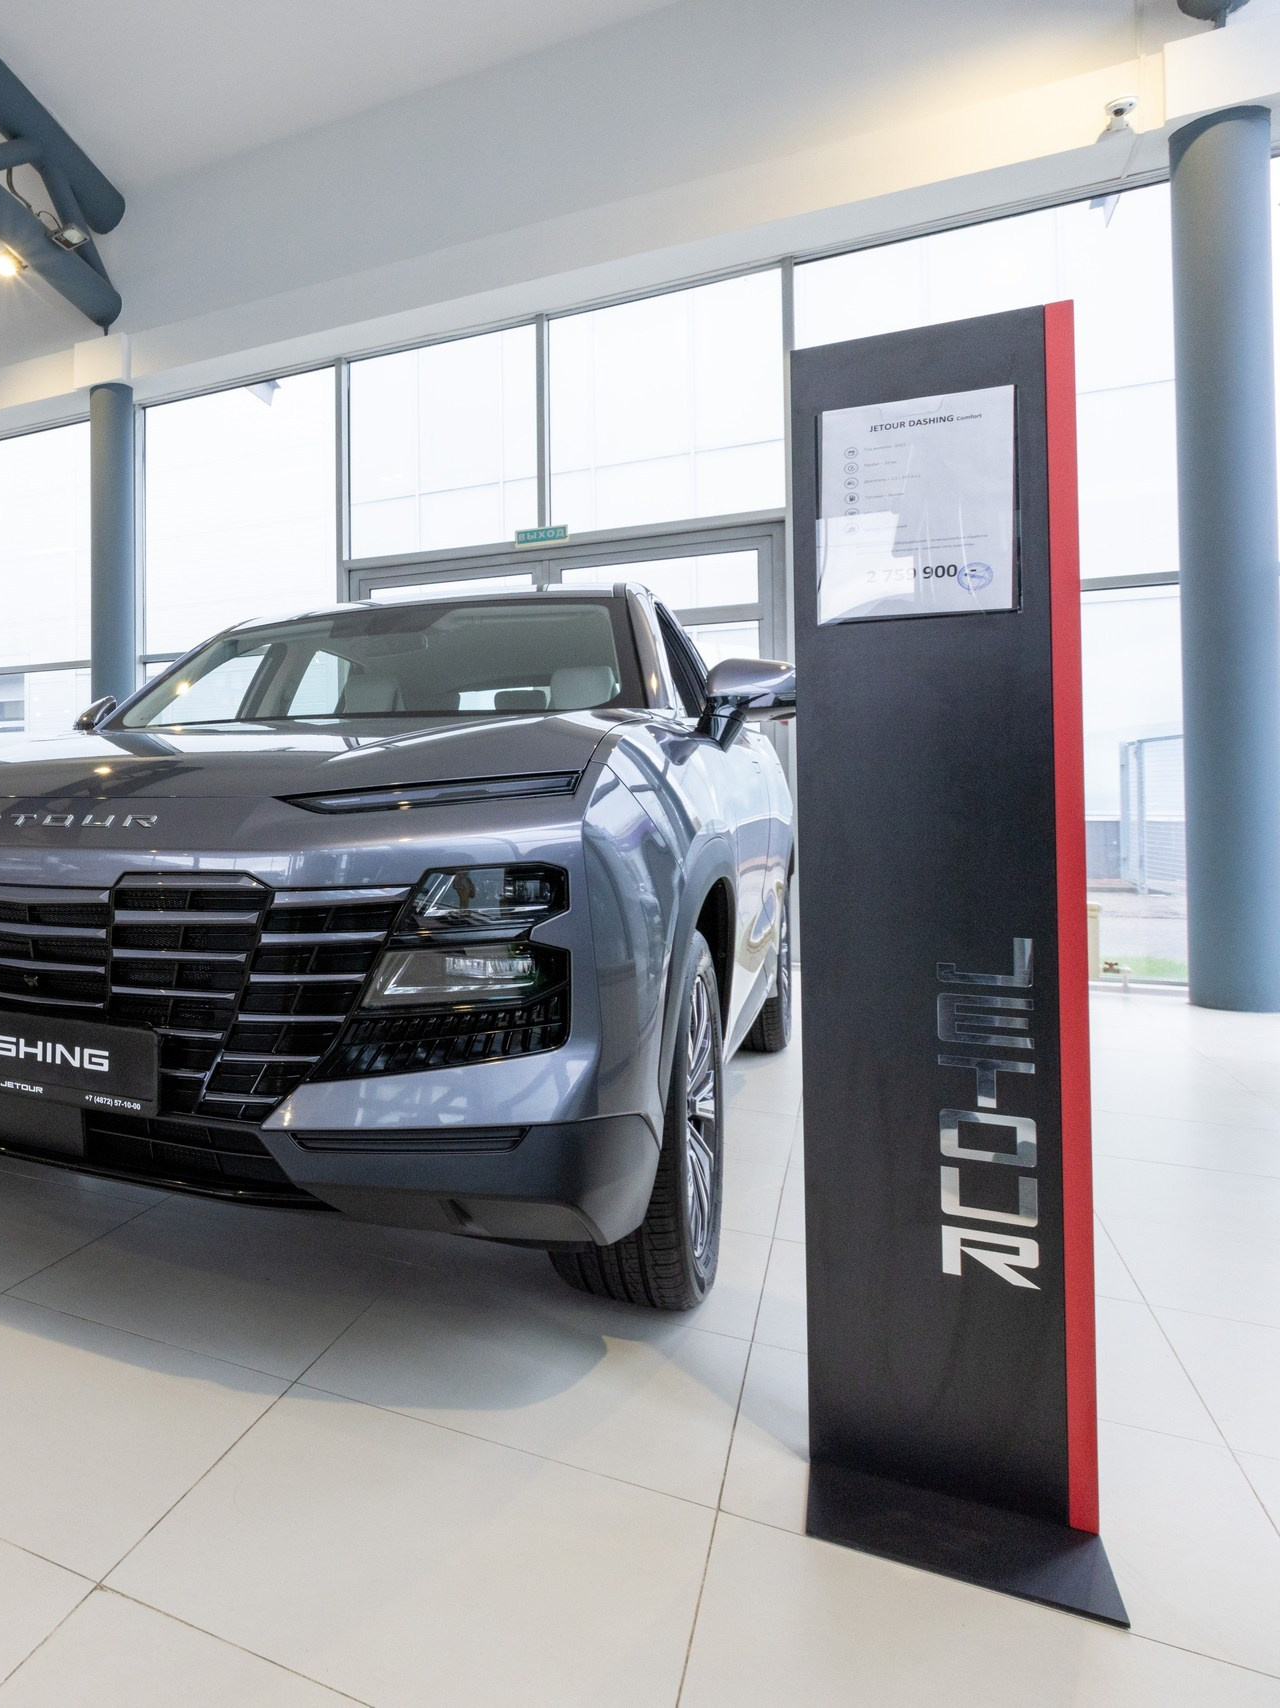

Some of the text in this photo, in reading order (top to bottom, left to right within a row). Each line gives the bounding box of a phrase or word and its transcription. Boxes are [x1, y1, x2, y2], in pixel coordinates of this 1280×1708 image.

[869, 420, 906, 432] JETOUR
[908, 414, 954, 428] DASHING
[518, 528, 565, 541] ВЫХОД
[922, 564, 958, 579] 900
[0, 1080, 43, 1094] JETOUR
[85, 1094, 141, 1111] +7 (4872) 57-10-00
[936, 937, 1041, 1291] JETOUR
